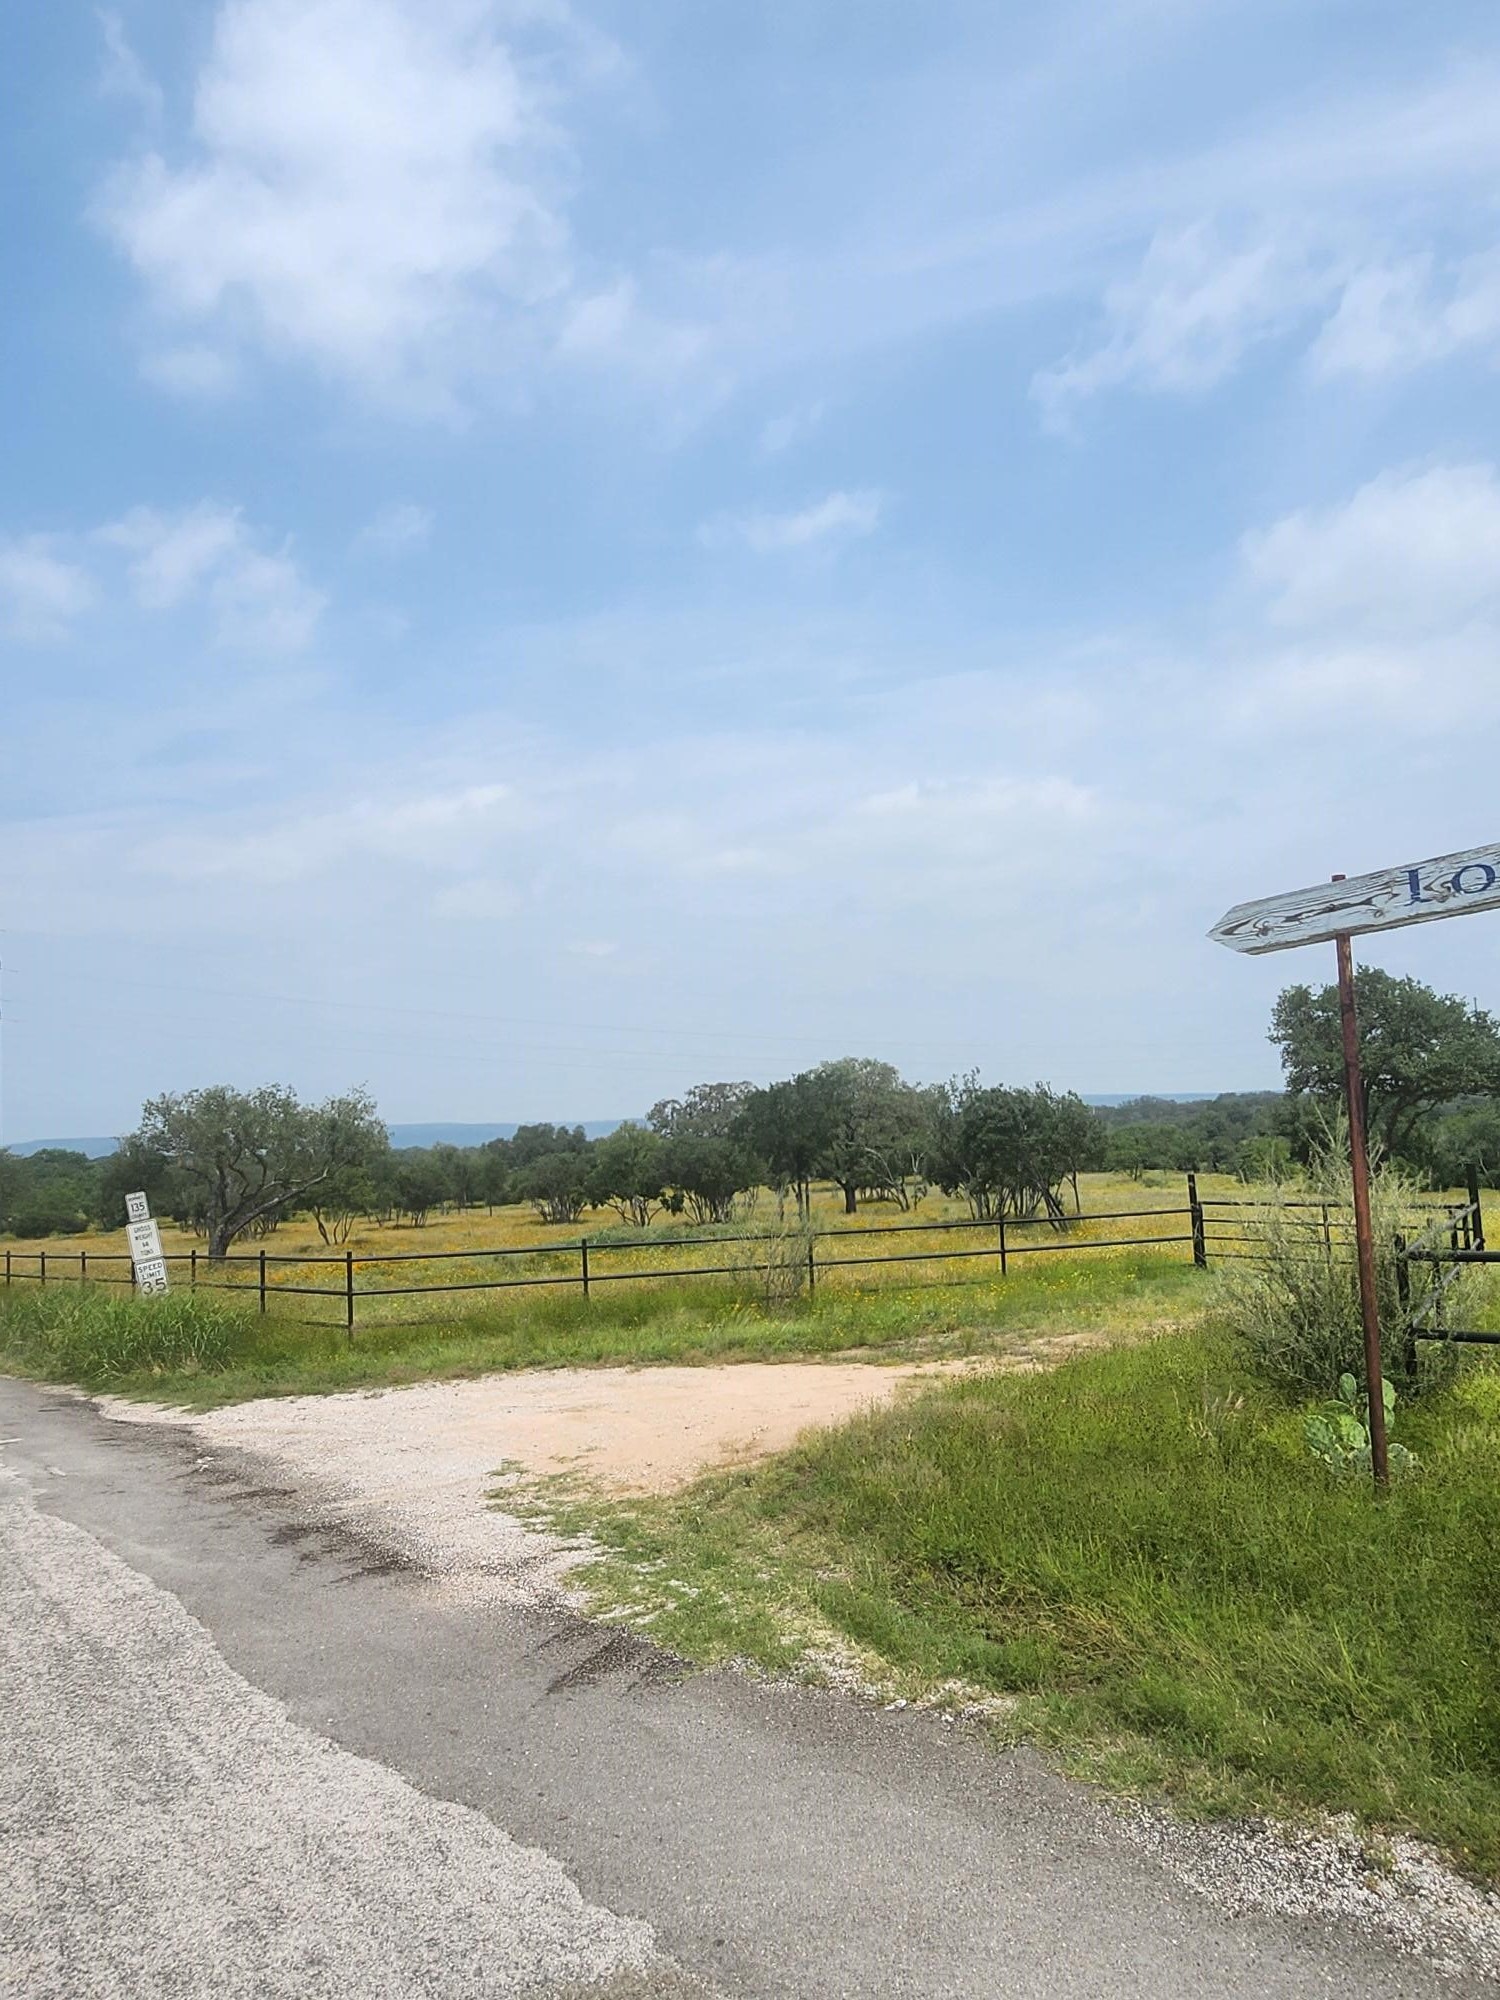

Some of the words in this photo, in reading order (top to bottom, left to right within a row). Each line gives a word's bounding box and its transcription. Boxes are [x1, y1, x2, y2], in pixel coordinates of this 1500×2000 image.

[130, 1202, 145, 1212] 135
[138, 1262, 162, 1273] SPEED
[141, 1270, 161, 1280] LIMIT
[142, 1277, 166, 1295] 35
